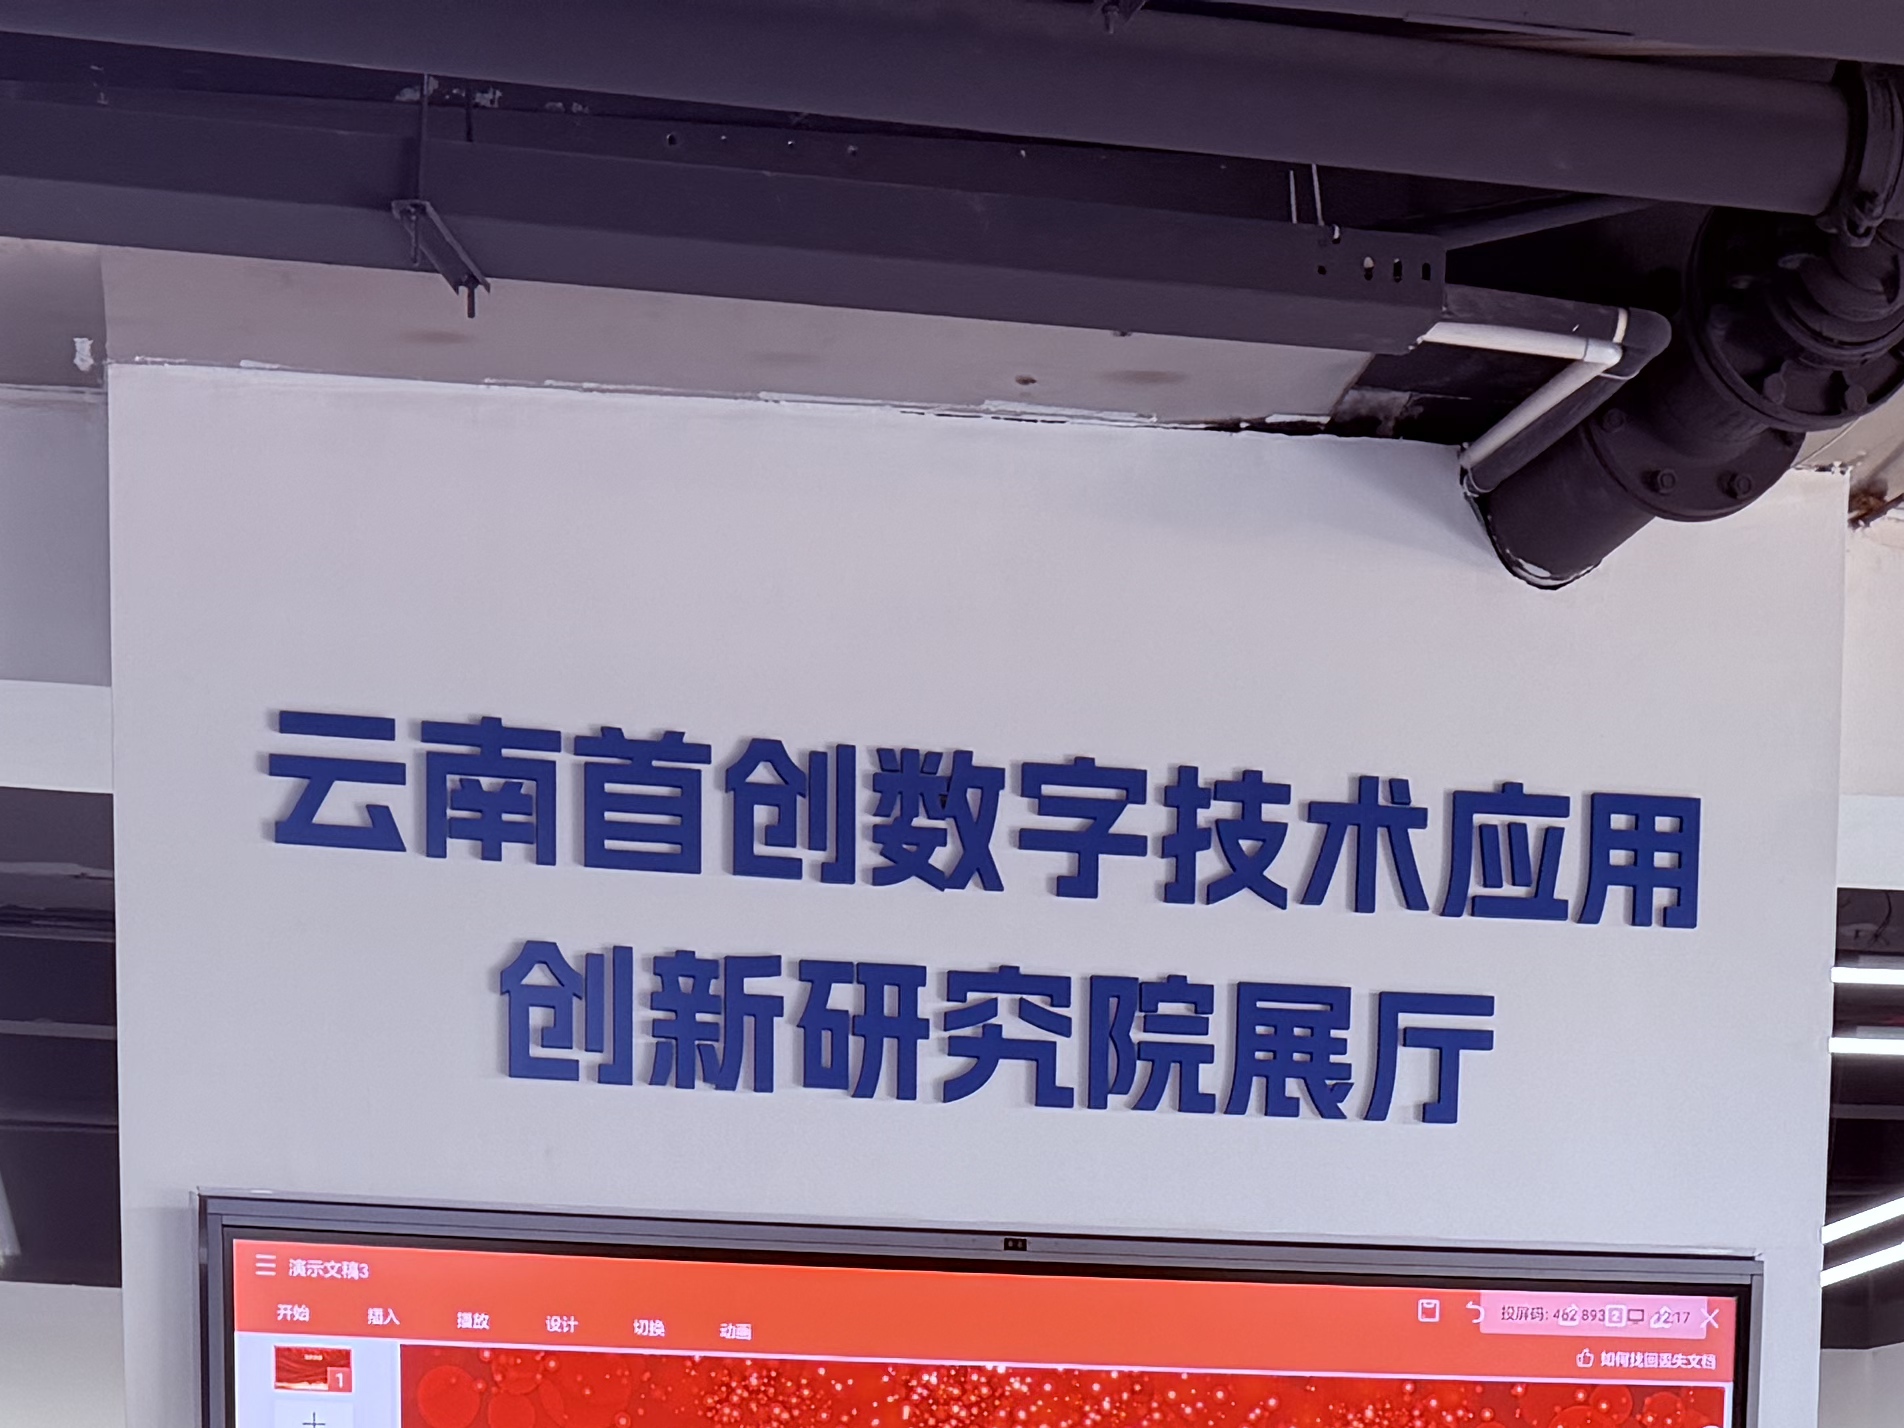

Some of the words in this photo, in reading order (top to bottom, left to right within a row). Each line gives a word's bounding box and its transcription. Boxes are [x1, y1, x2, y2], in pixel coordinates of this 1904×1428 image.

[265, 709, 1701, 928] 云南首创数字技术应用
[496, 939, 1496, 1125] 创新研究院展厅
[276, 1303, 311, 1322] 开始
[367, 1307, 401, 1327] 插入
[456, 1312, 490, 1332] 播放
[545, 1315, 579, 1335] 设计
[632, 1319, 666, 1339] 切换
[719, 1322, 753, 1342] 动画
[288, 1258, 370, 1281] 演示文稿3
